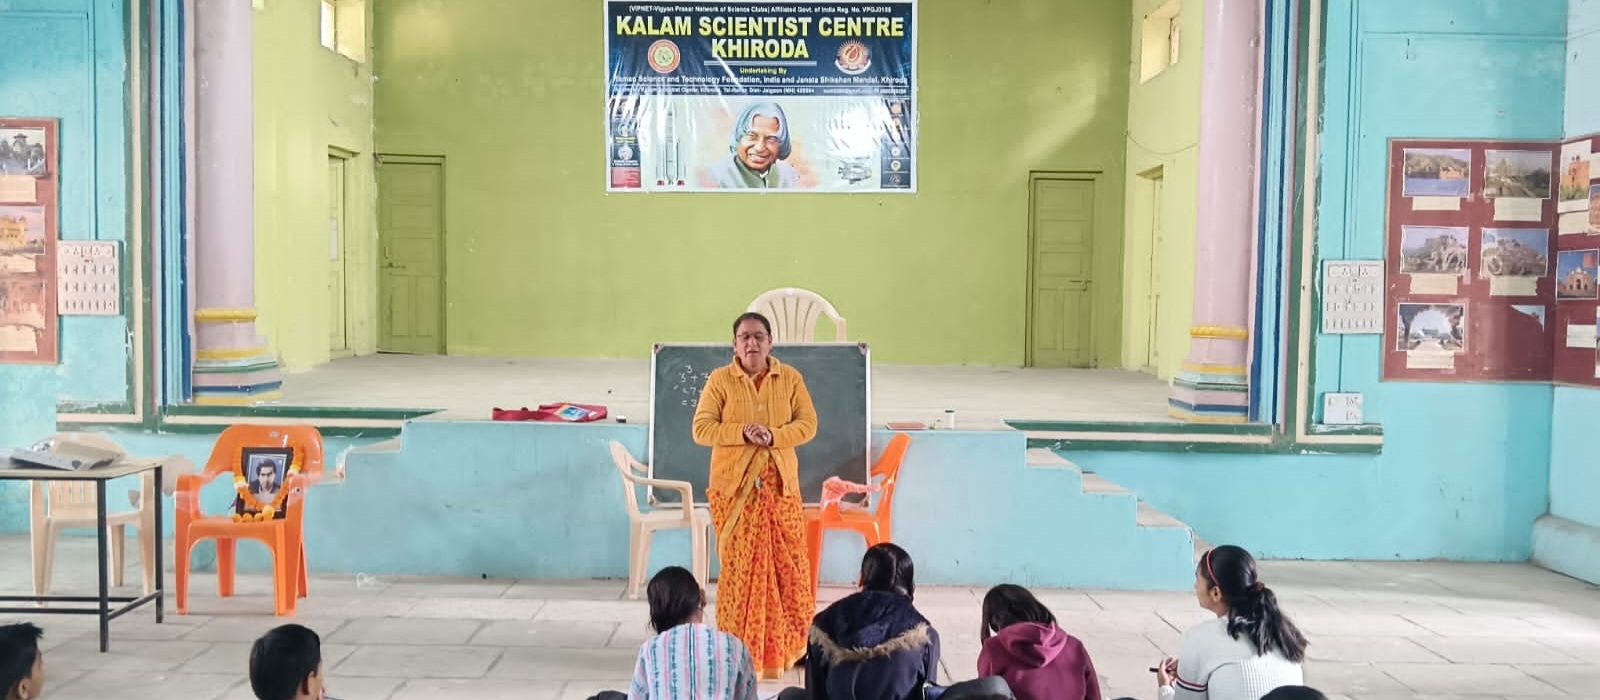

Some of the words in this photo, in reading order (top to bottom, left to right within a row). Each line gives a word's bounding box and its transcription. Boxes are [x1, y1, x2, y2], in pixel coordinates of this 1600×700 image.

[837, 6, 849, 14] Reg.
[616, 16, 692, 36] KALAM
[698, 16, 812, 36] SCIENTIST
[818, 16, 904, 37] CENTRE
[712, 38, 808, 59] KHIRODA
[682, 76, 720, 84] Technology
